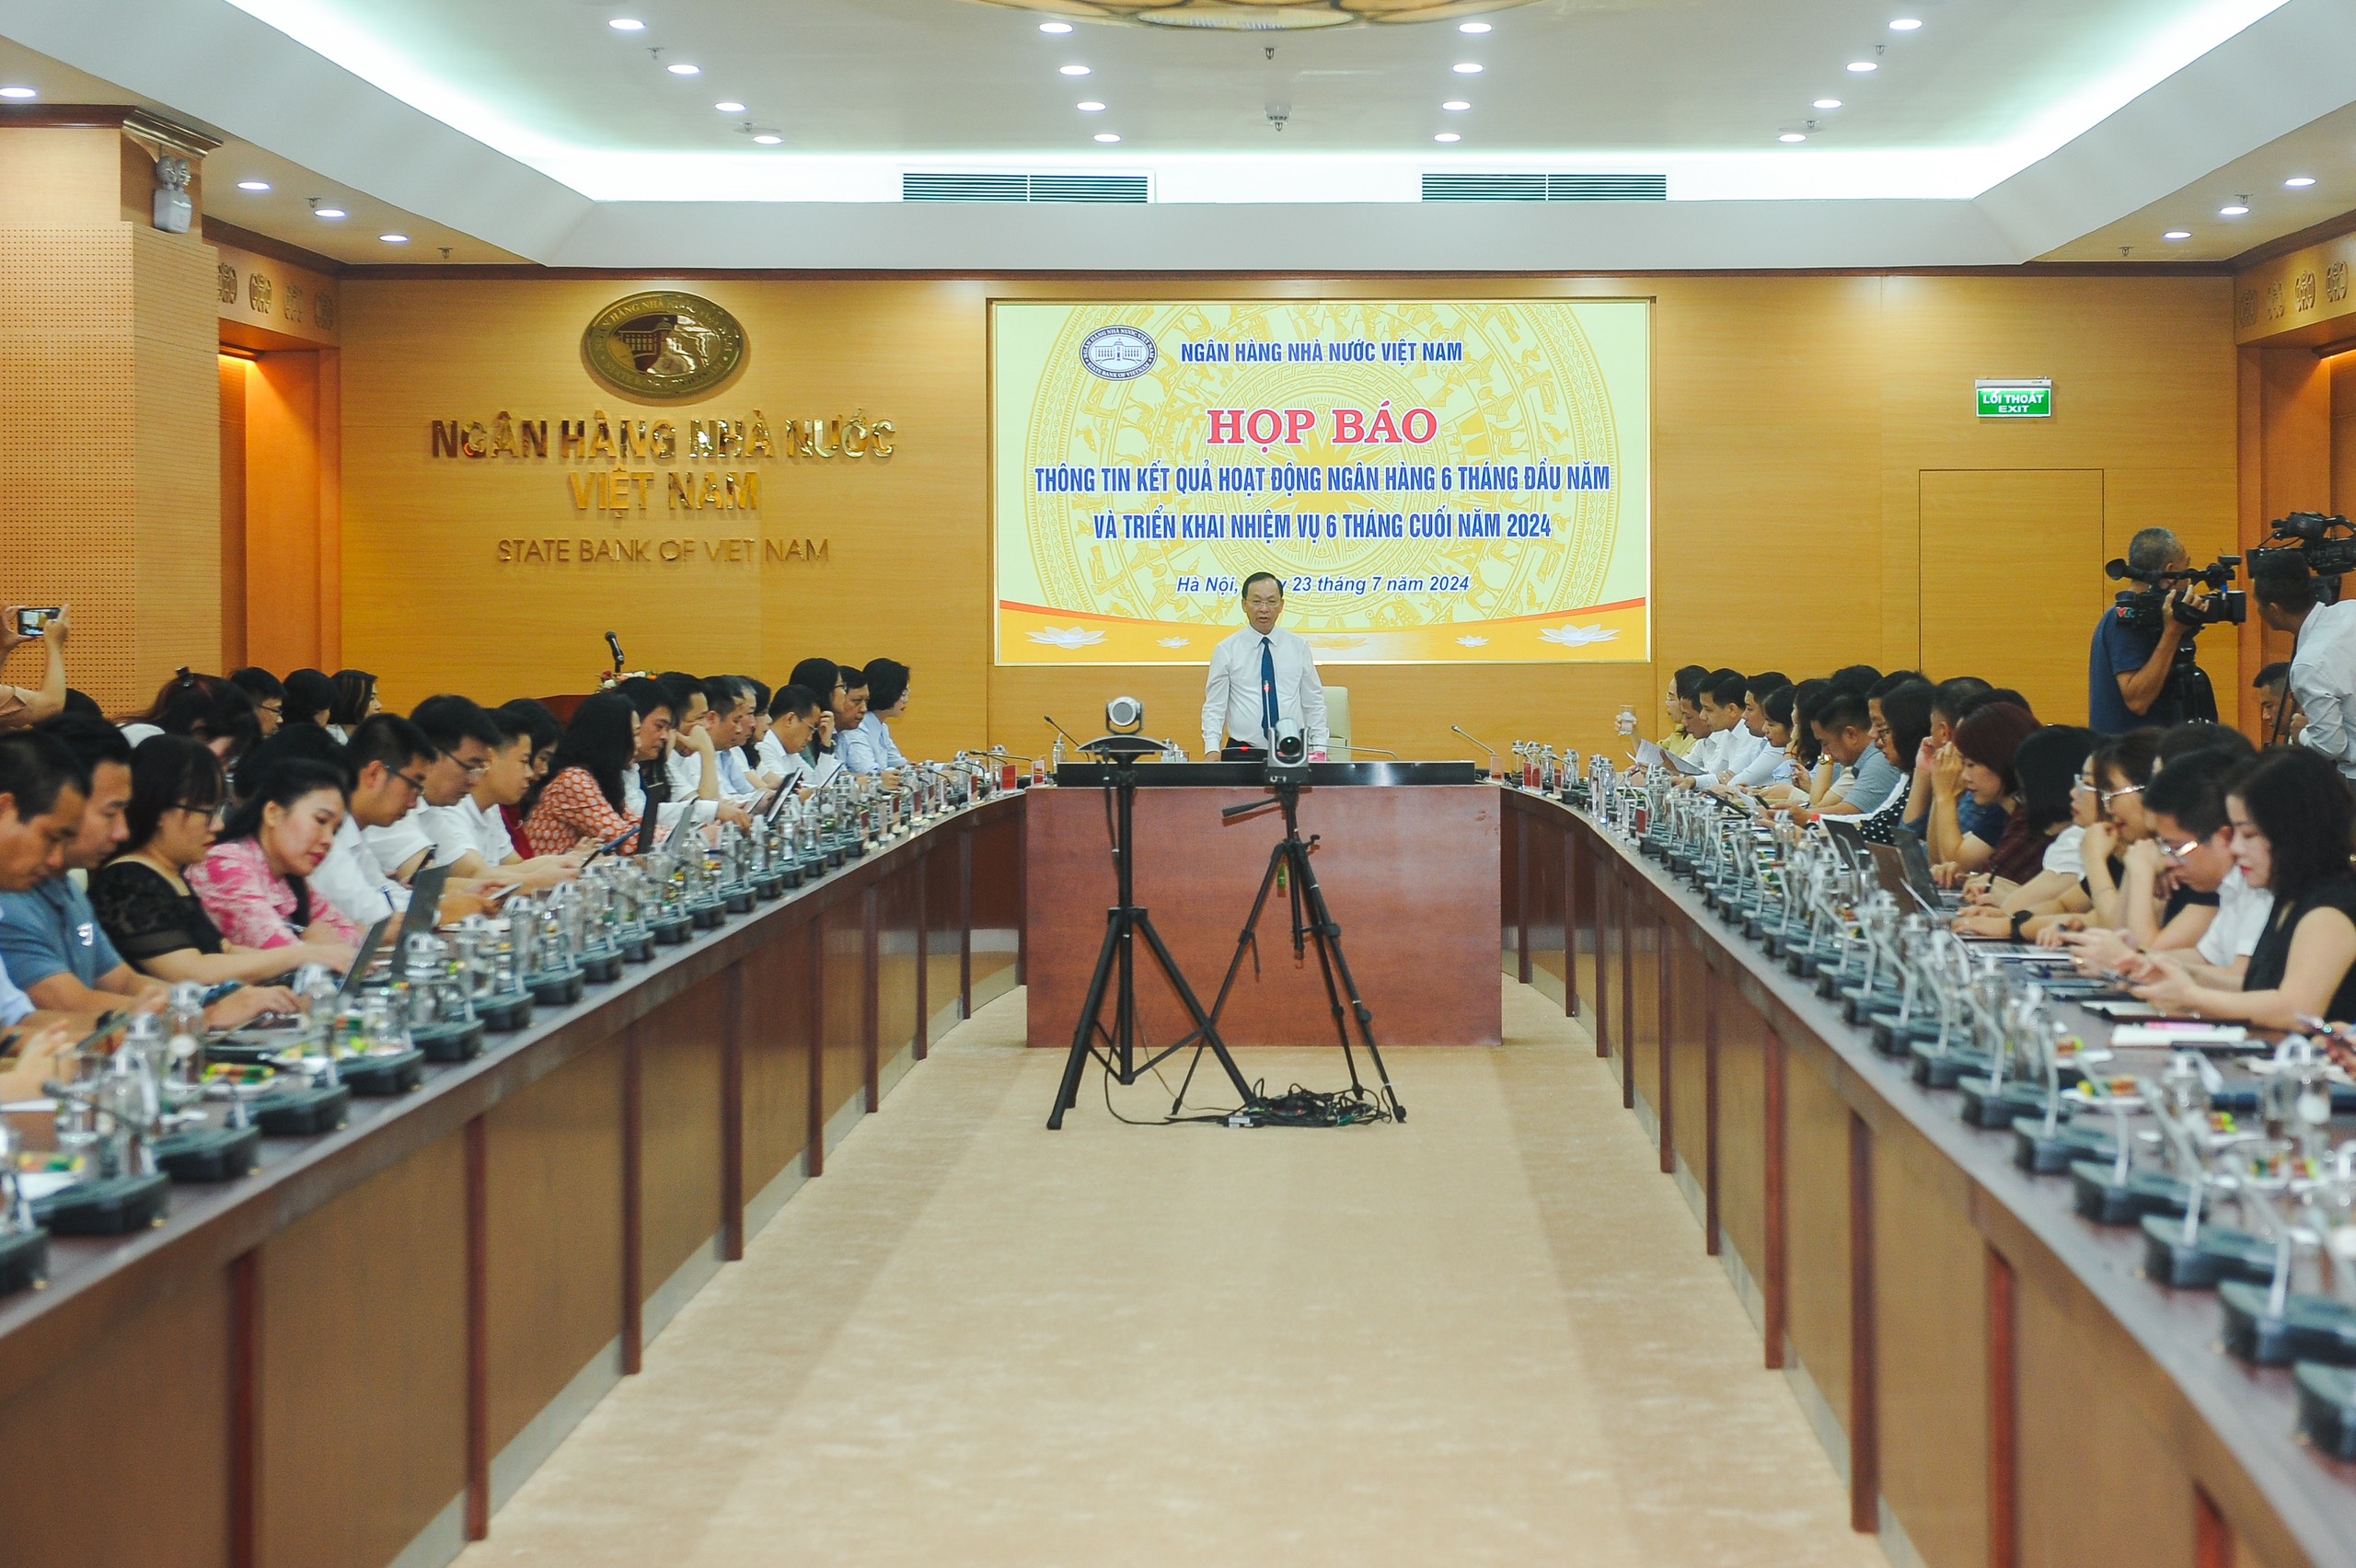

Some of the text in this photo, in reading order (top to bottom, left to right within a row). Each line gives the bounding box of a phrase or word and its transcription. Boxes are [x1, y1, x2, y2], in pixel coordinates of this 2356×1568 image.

[1181, 339, 1462, 366] NGÂN HÀNG NHÀ NƯỚC VIỆT NAM
[1998, 405, 2029, 413] EXIT
[2004, 392, 2044, 404] THOÁT
[432, 408, 896, 459] NGÂN HÀNG NHÀ NƯỚC
[1207, 400, 1438, 454] HỌP BÁO
[568, 467, 759, 518] VIỆT NAM
[1034, 458, 1610, 497] THÔNG TIN KẾT QUẢ HOẠT ĐỘNG NGÂN HÀNG 6 THÁNG ĐẦU NĂM
[1093, 505, 1552, 544] VÀ TRIỂN KHAI NHIỆM VỤ 6 THÁNG CUỐI NĂM 2024
[498, 538, 829, 562] STATE BANK OF VIET NAM
[1176, 577, 1199, 592] Hà
[1205, 576, 1239, 595] Nội,
[1292, 576, 1312, 592] 23
[1317, 576, 1366, 595] tháng
[1372, 577, 1382, 592] 7
[1387, 576, 1424, 592] năm
[1429, 576, 1469, 591] 2024
